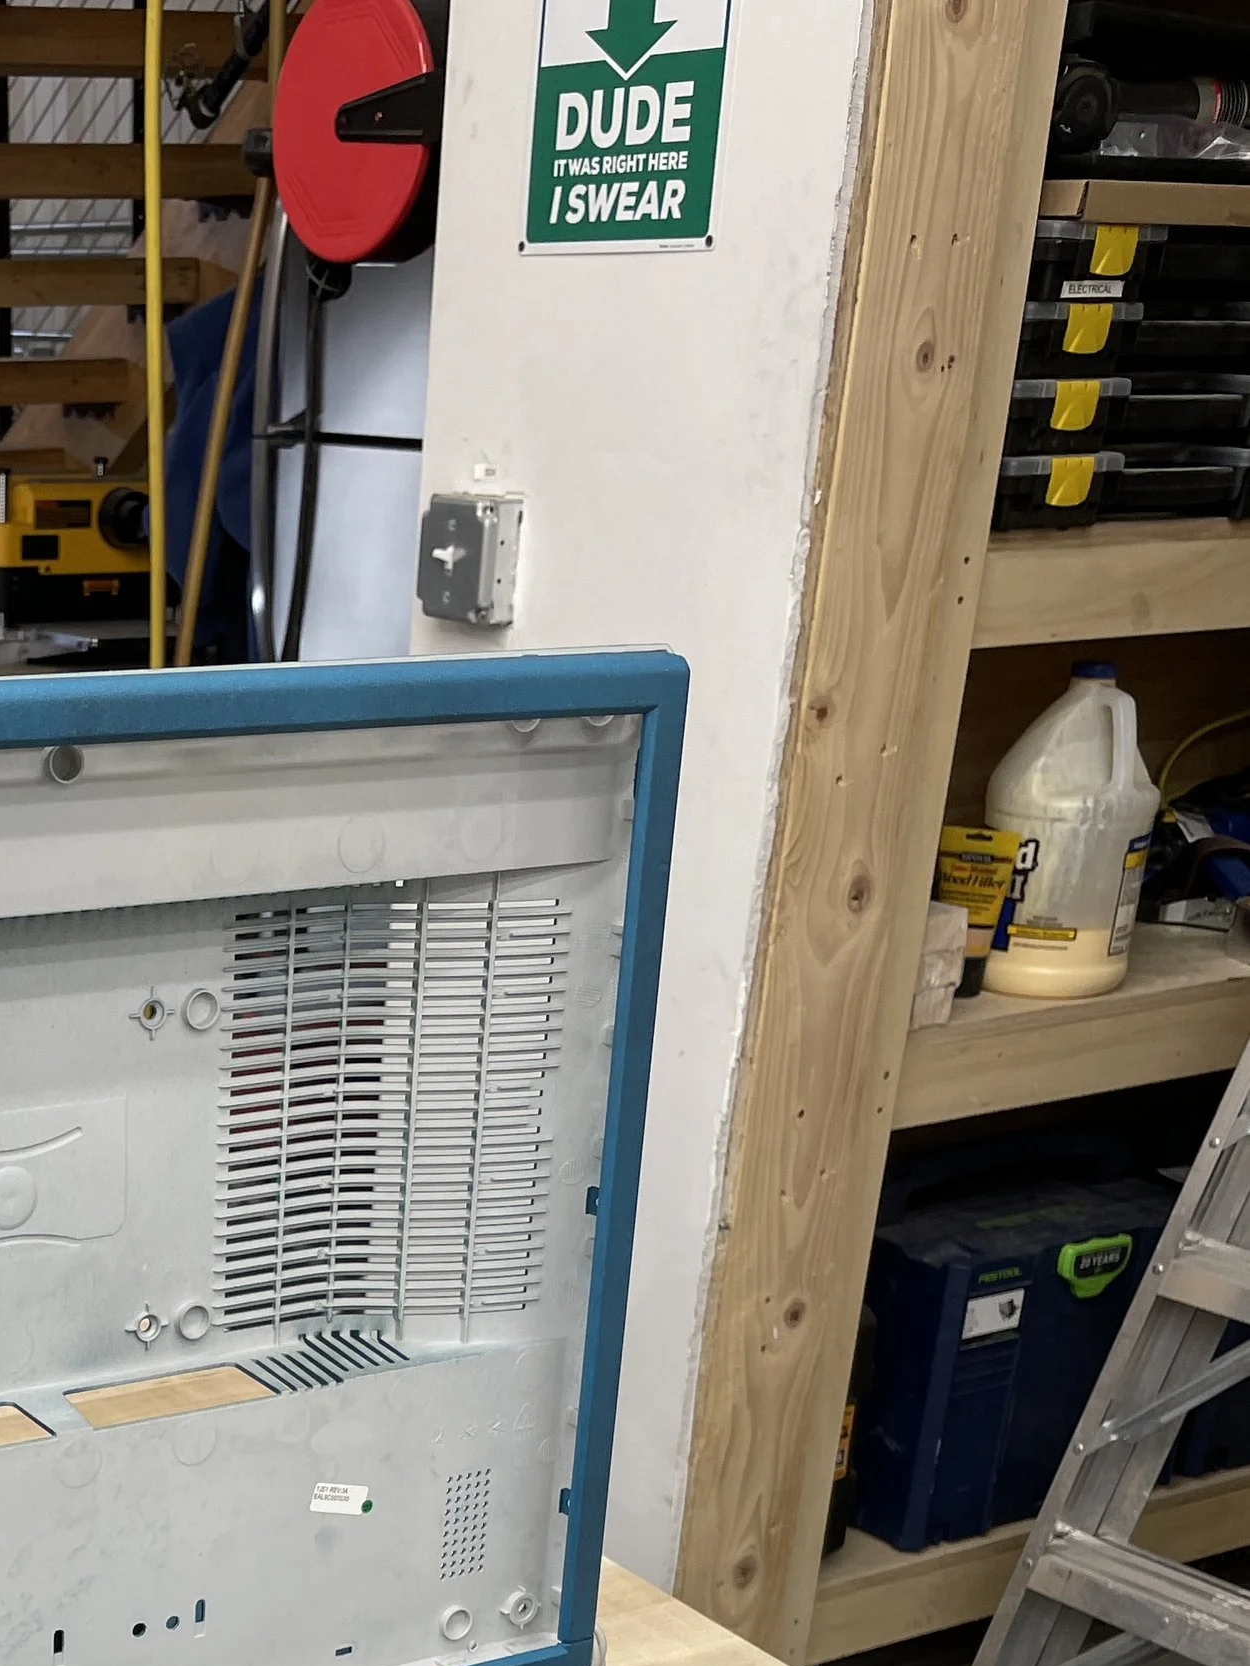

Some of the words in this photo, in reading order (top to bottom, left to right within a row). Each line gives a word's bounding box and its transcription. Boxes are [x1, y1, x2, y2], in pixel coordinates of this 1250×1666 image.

[555, 80, 695, 151] DUDE
[553, 158, 568, 177] IT
[568, 156, 601, 176] WAS
[602, 154, 647, 174] RIGHT
[648, 150, 689, 171] HERE
[549, 186, 563, 225] I
[564, 179, 686, 225] SWEAR
[1068, 284, 1111, 295] ELECTRICAL
[1092, 1247, 1121, 1266] YEARS
